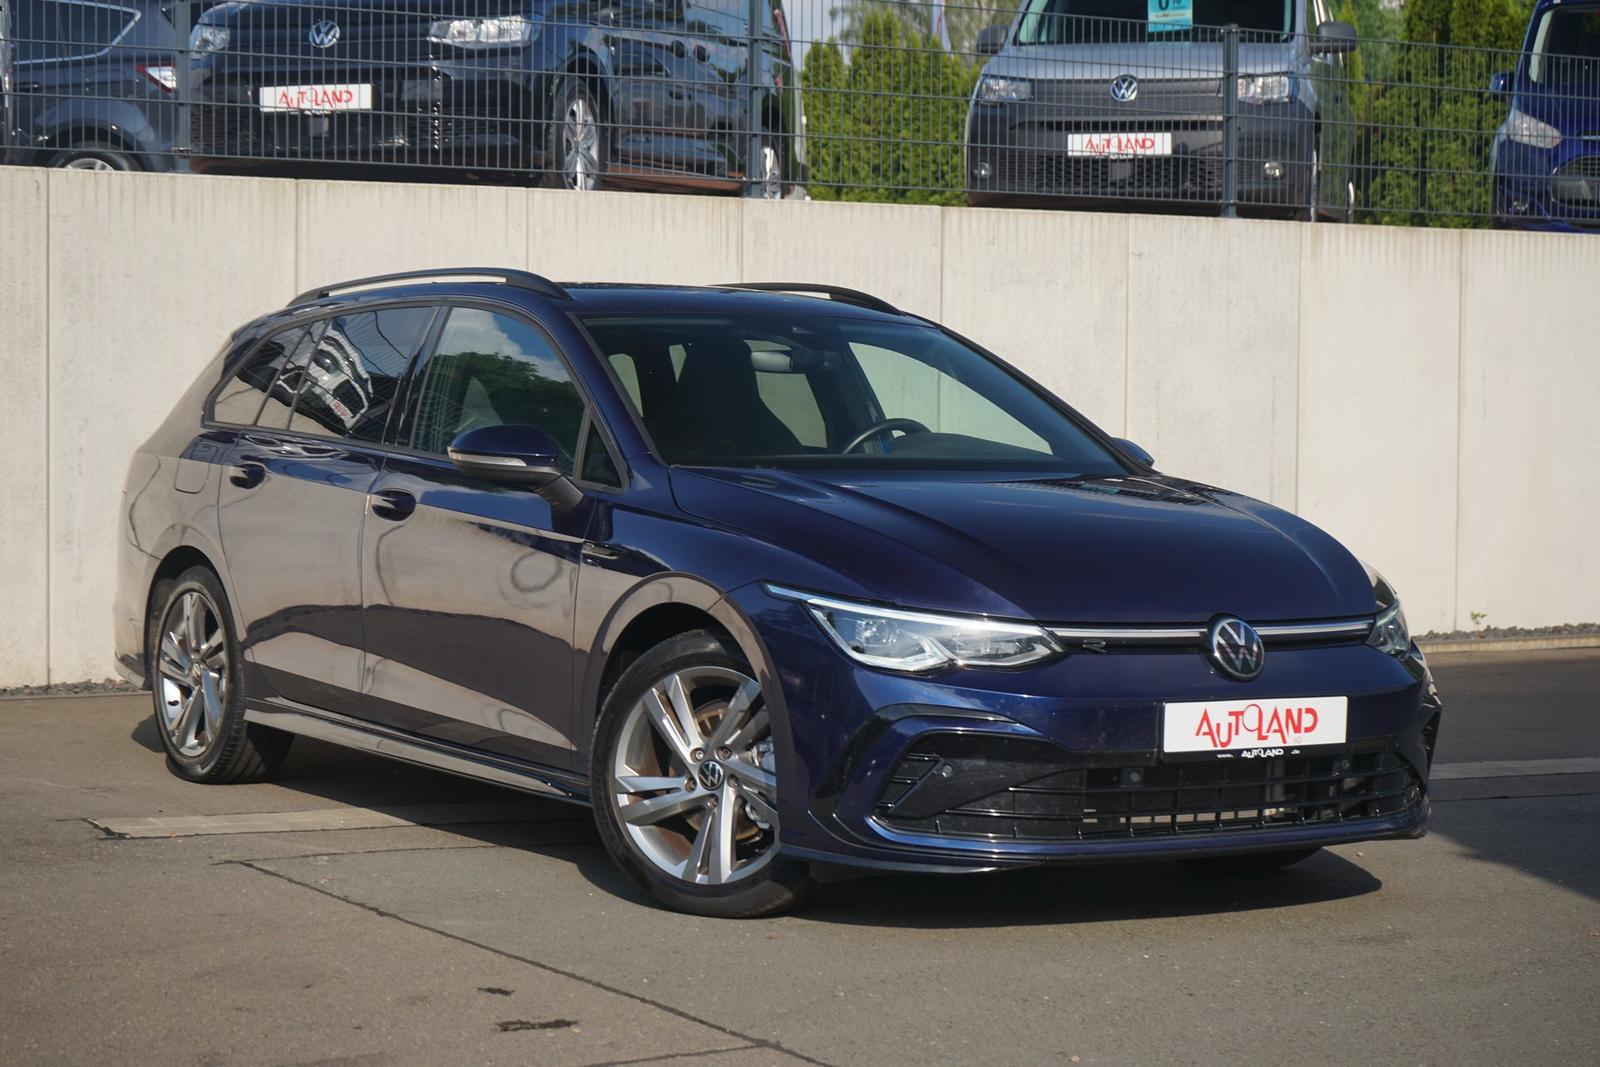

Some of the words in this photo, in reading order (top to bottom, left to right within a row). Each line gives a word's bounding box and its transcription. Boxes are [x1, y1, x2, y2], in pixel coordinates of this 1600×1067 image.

[278, 88, 353, 110] AUTOLAND
[1085, 136, 1154, 154] AUTOLAND
[1195, 703, 1319, 748] AUTOLAND
[1241, 748, 1284, 758] AUTOLAND
